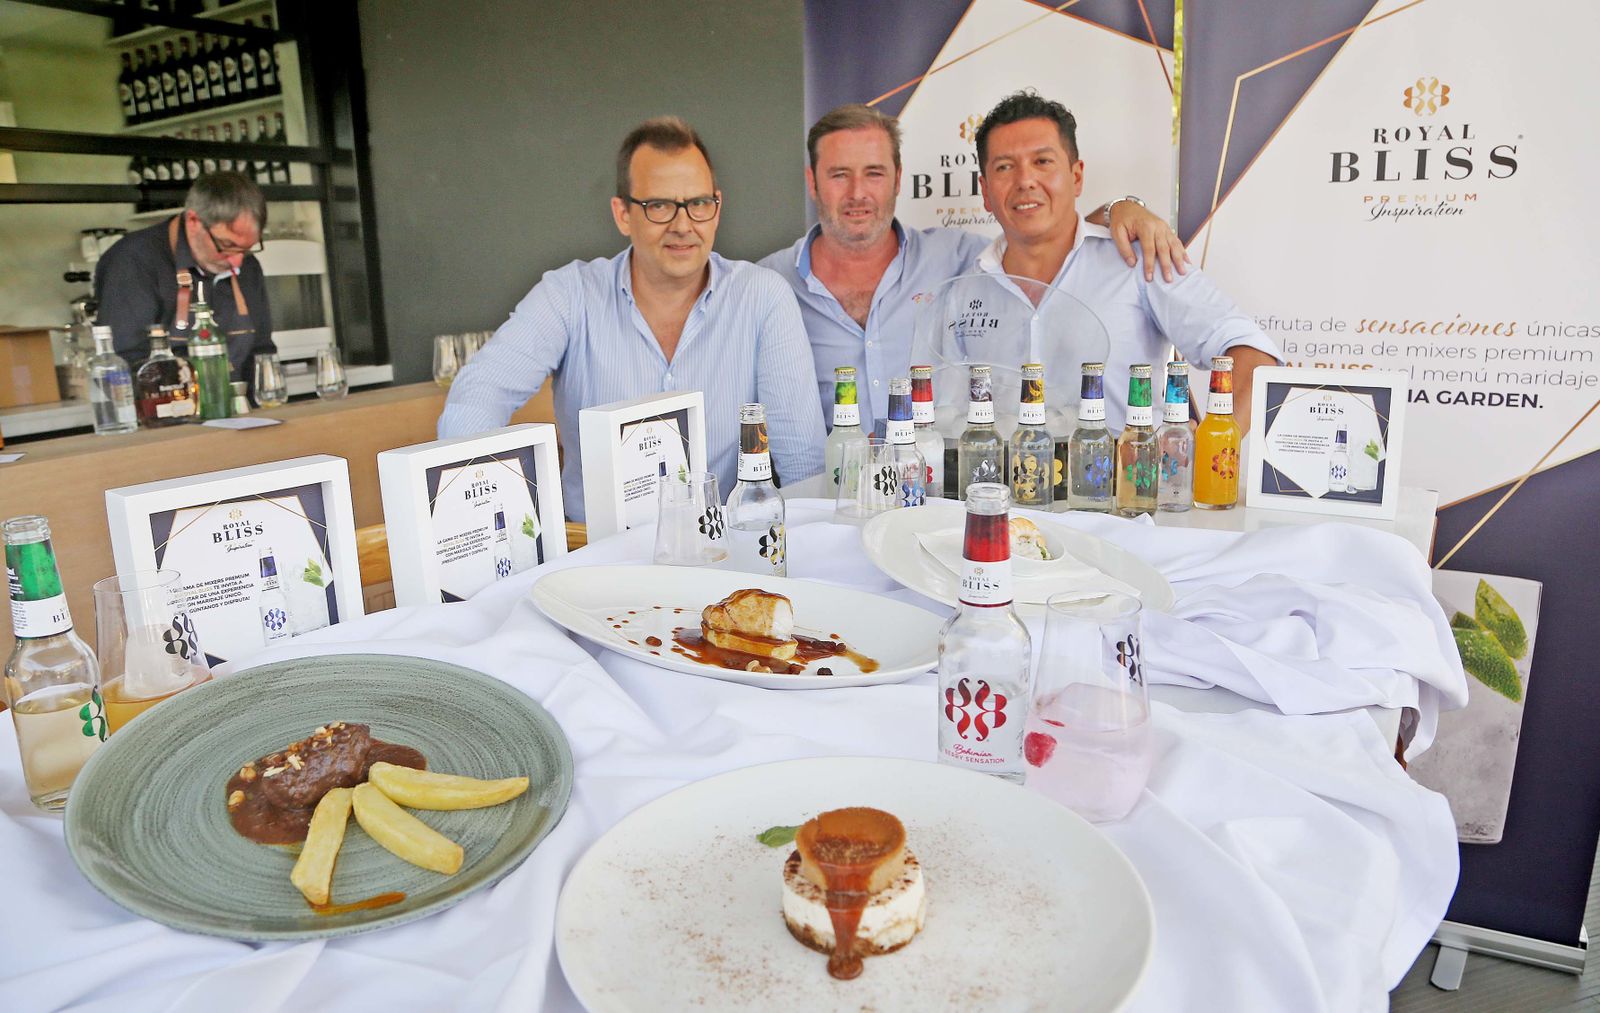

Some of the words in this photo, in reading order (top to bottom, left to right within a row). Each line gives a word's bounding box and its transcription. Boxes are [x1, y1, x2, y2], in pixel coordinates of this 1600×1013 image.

[1372, 123, 1476, 144] ROYAL
[940, 153, 978, 168] ROY
[1328, 145, 1518, 183] BLISS
[911, 170, 981, 199] BLI
[1364, 193, 1477, 203] PREMIUM
[936, 207, 981, 215] PREM
[1365, 200, 1464, 223] Inspiration
[1254, 315, 1313, 331] isfruta
[1320, 316, 1346, 332] de
[1354, 313, 1518, 336] sensaciones
[1527, 320, 1600, 338] únicas
[1283, 338, 1298, 353] la
[1305, 342, 1363, 357] gama
[1371, 341, 1398, 357] de
[1406, 342, 1477, 359] mixers
[1484, 346, 1593, 363] premium
[1423, 367, 1487, 383] menú
[1496, 370, 1598, 390] maridaje
[1407, 389, 1430, 404] IA
[1436, 390, 1544, 409] GARDEN.
[1309, 406, 1344, 415] BLISS
[464, 482, 498, 500] BLISS
[212, 524, 264, 543] BLISS
[223, 520, 251, 530] ROYAL
[962, 578, 1000, 591] BLISS
[965, 755, 1005, 764] SENSATION
